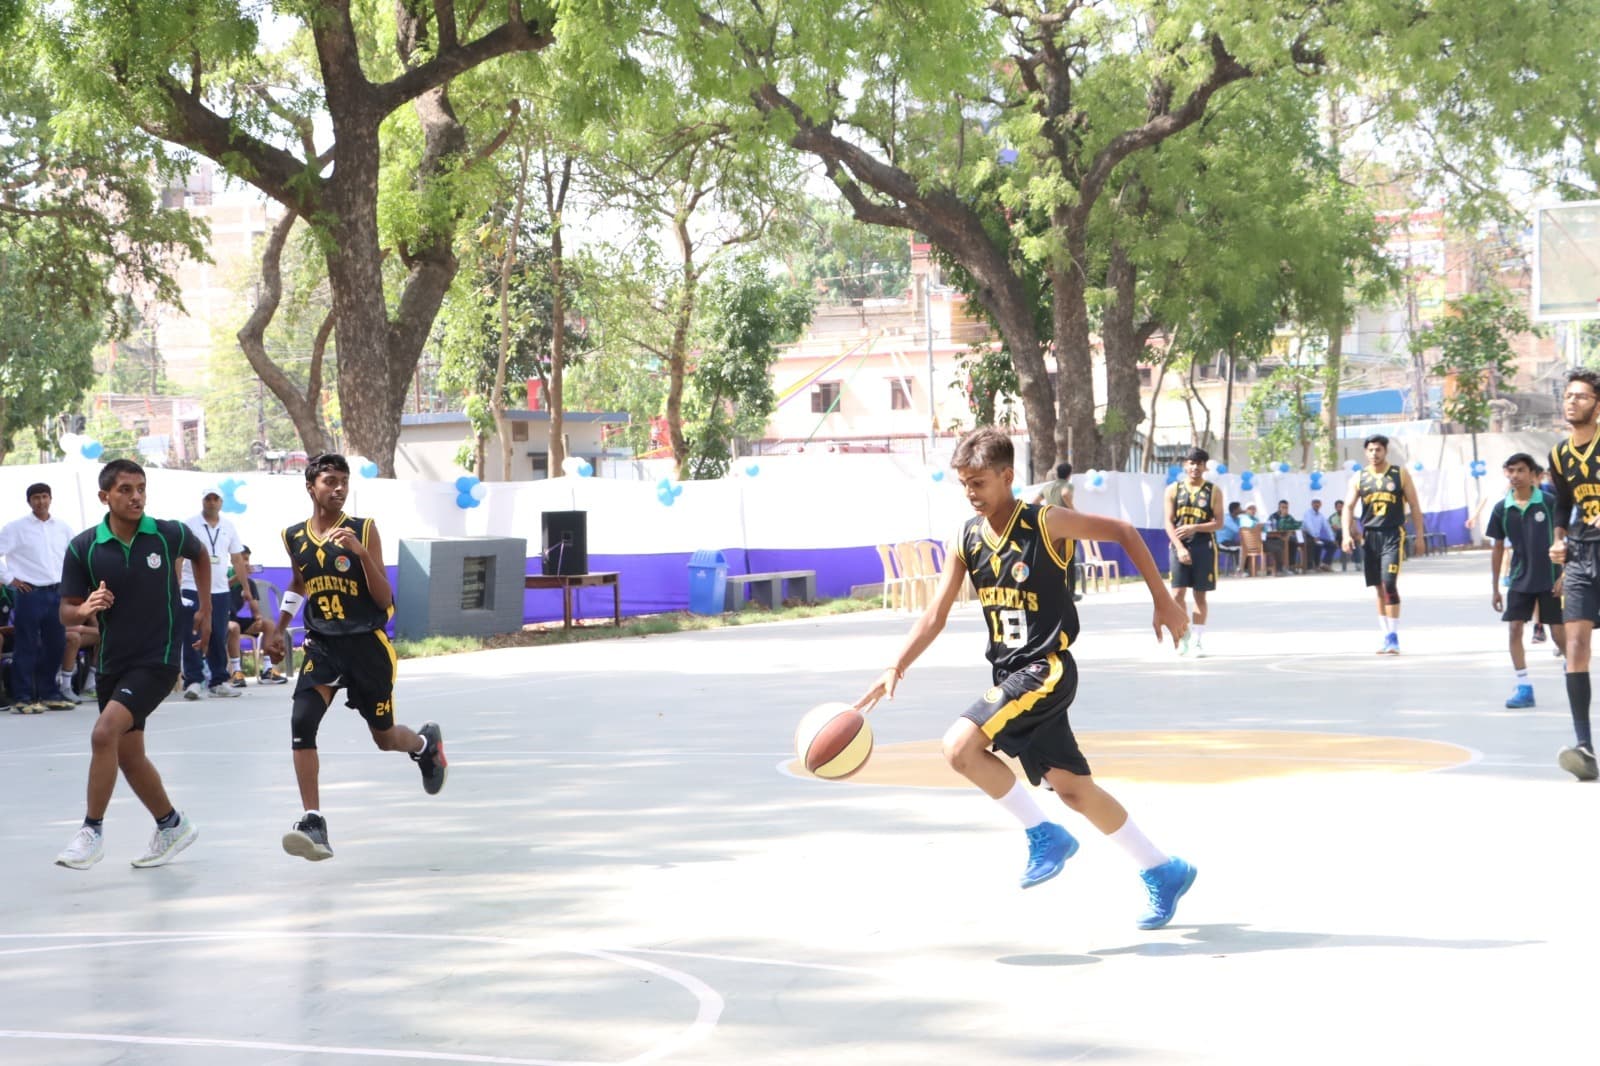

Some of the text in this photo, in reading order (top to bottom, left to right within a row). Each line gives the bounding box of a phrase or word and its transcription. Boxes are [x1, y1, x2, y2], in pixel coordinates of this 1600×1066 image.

[317, 593, 345, 620] 24
[990, 609, 1028, 649] 18
[375, 699, 391, 716] 24
